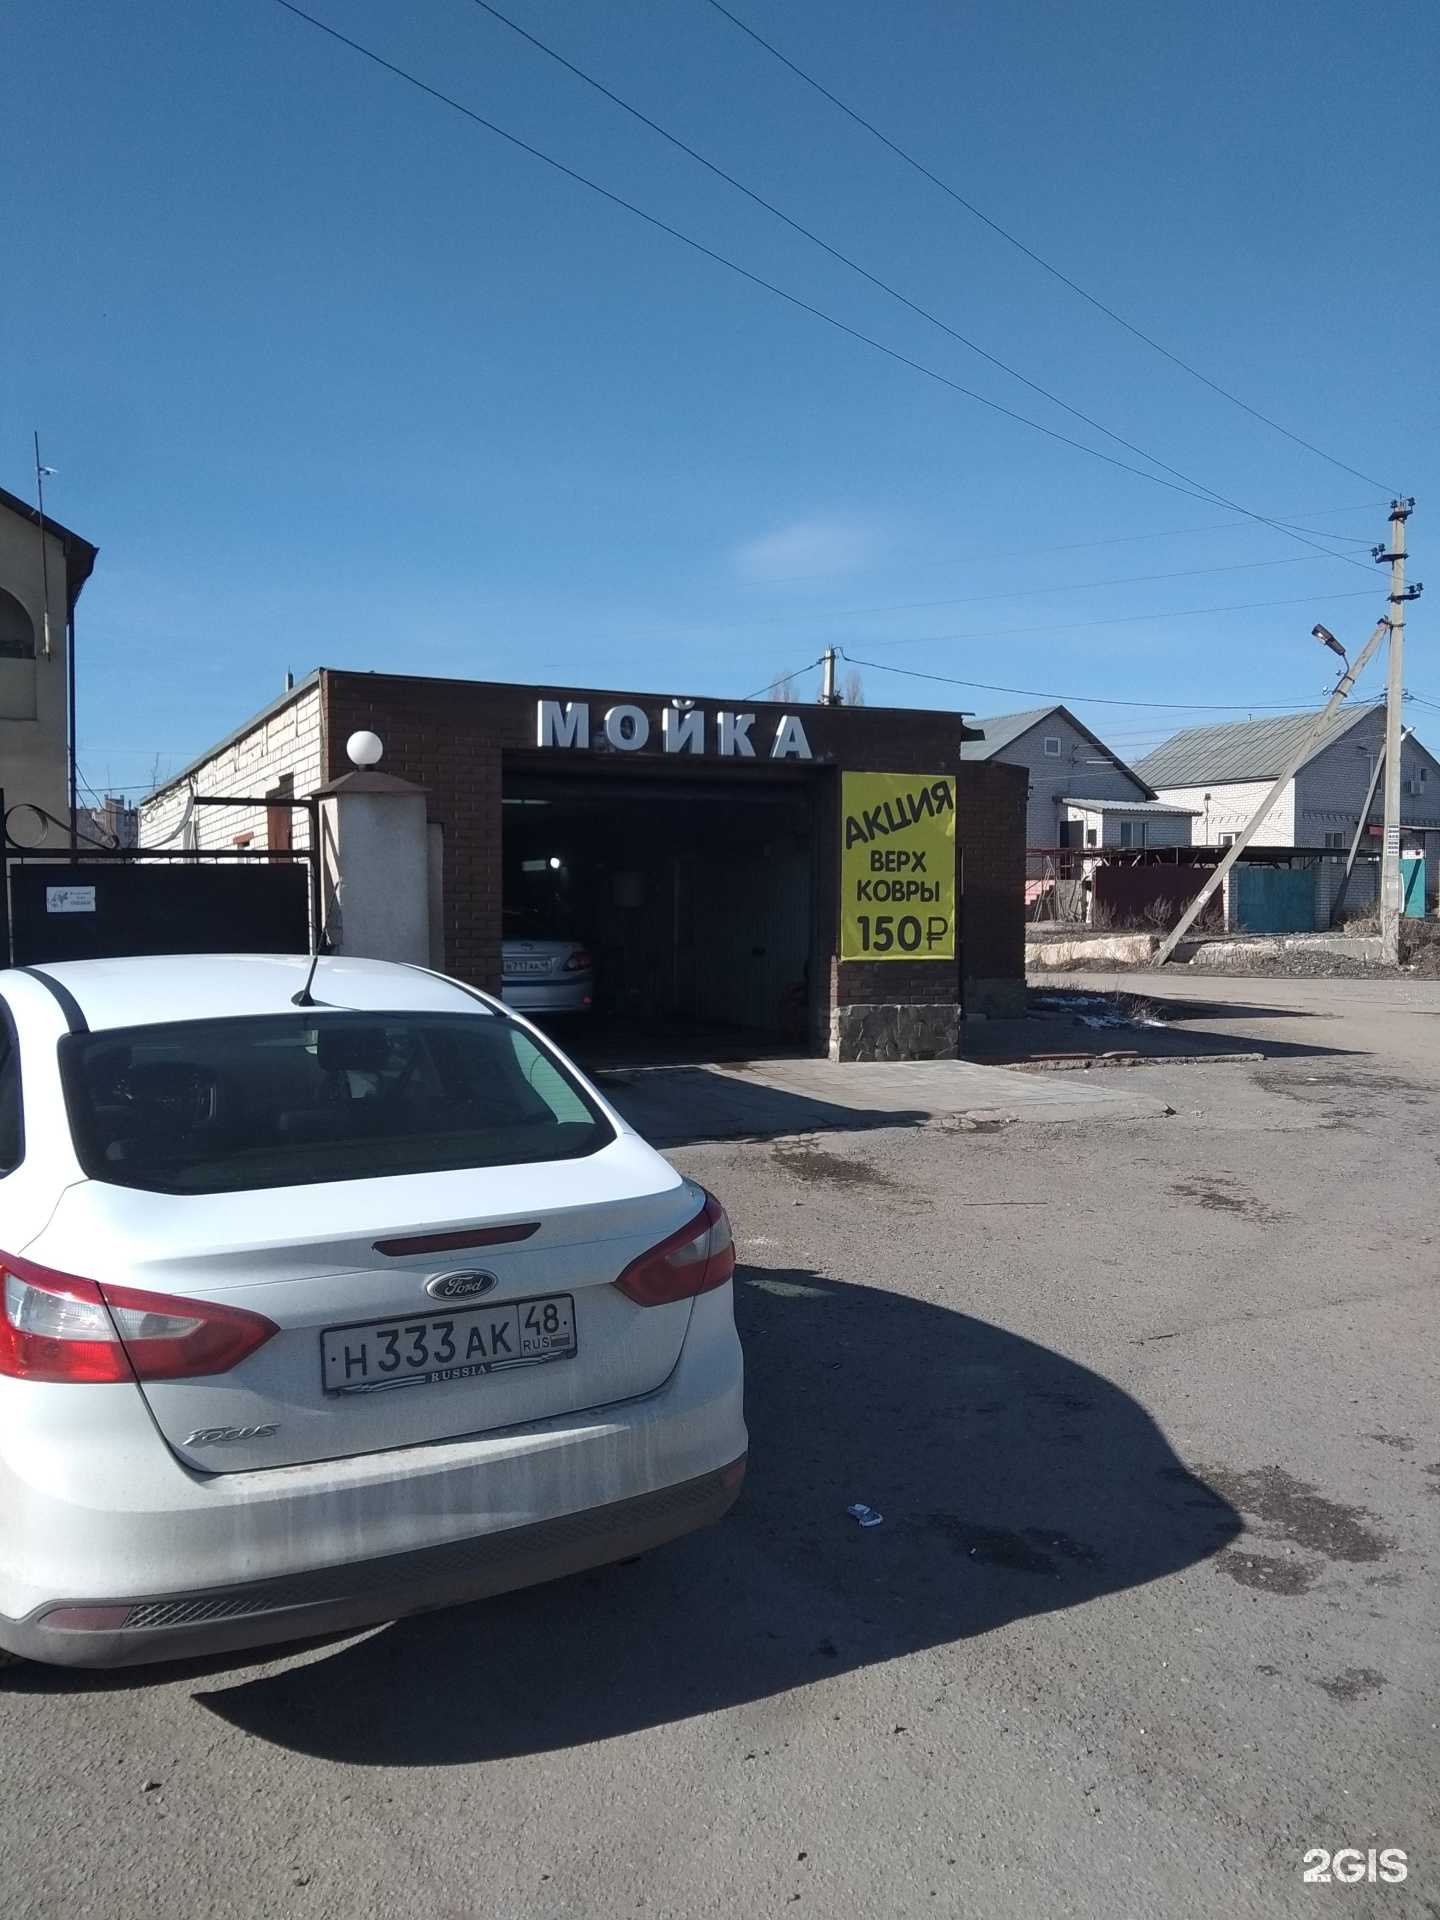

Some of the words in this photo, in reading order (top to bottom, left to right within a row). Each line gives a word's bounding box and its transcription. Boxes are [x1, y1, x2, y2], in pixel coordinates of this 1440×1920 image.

[537, 698, 813, 759] МОЙКА
[845, 780, 954, 850] АКЦИЯ
[870, 850, 927, 873] ВЕРХ
[857, 879, 940, 902] КОВРЫ
[444, 1275, 484, 1296] Ford
[523, 1336, 550, 1351] RUS
[431, 1365, 488, 1383] RUSSIA
